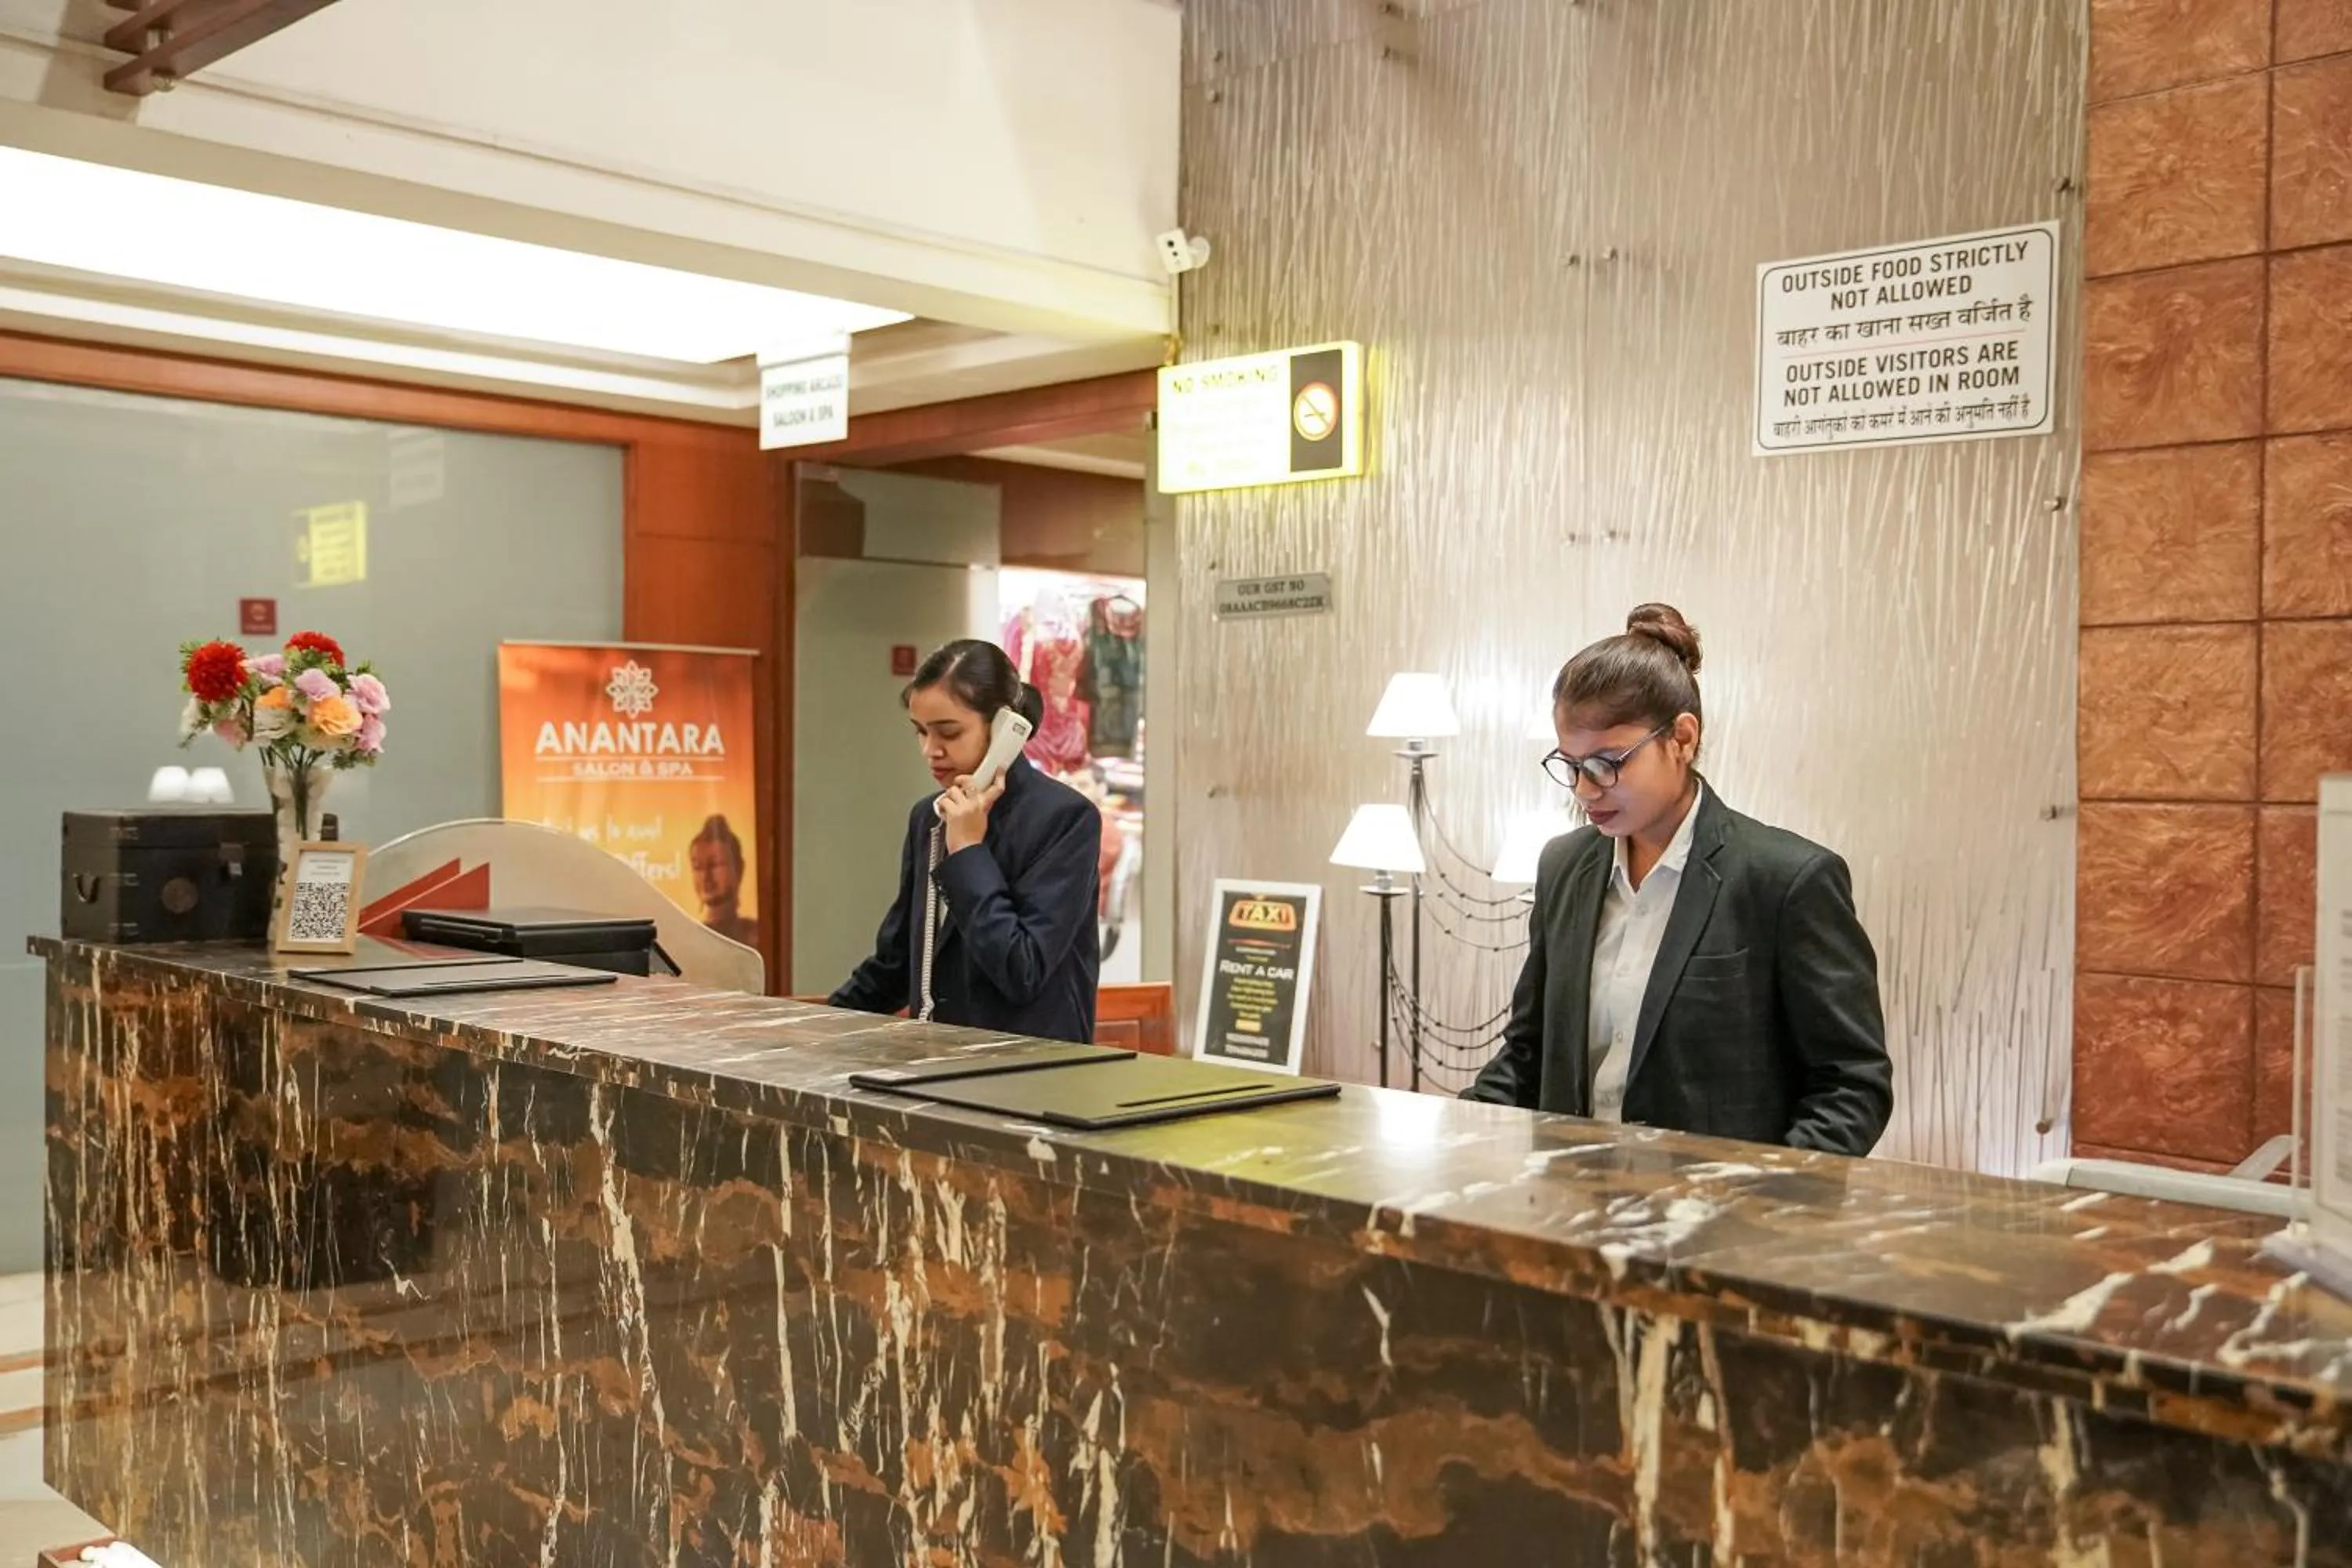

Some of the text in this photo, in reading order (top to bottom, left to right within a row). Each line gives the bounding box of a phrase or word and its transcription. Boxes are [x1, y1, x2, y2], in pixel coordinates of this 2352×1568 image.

[1782, 241, 2028, 293] OUTSIDE FOOD STRICTLY
[1831, 274, 1973, 311] NOT ALLOWED
[1777, 293, 2034, 347] बाहर का खाना सख्त वर्जित है
[1786, 340, 2019, 383] OUTSIDE VISITORS ARE
[1784, 366, 2020, 408] NOT ALLOWED IN ROOM
[535, 721, 726, 754] ANANTARA
[573, 760, 694, 778] SALON & SPA
[1238, 903, 1289, 923] TAXI
[1219, 960, 1294, 980] RENT A CAR
